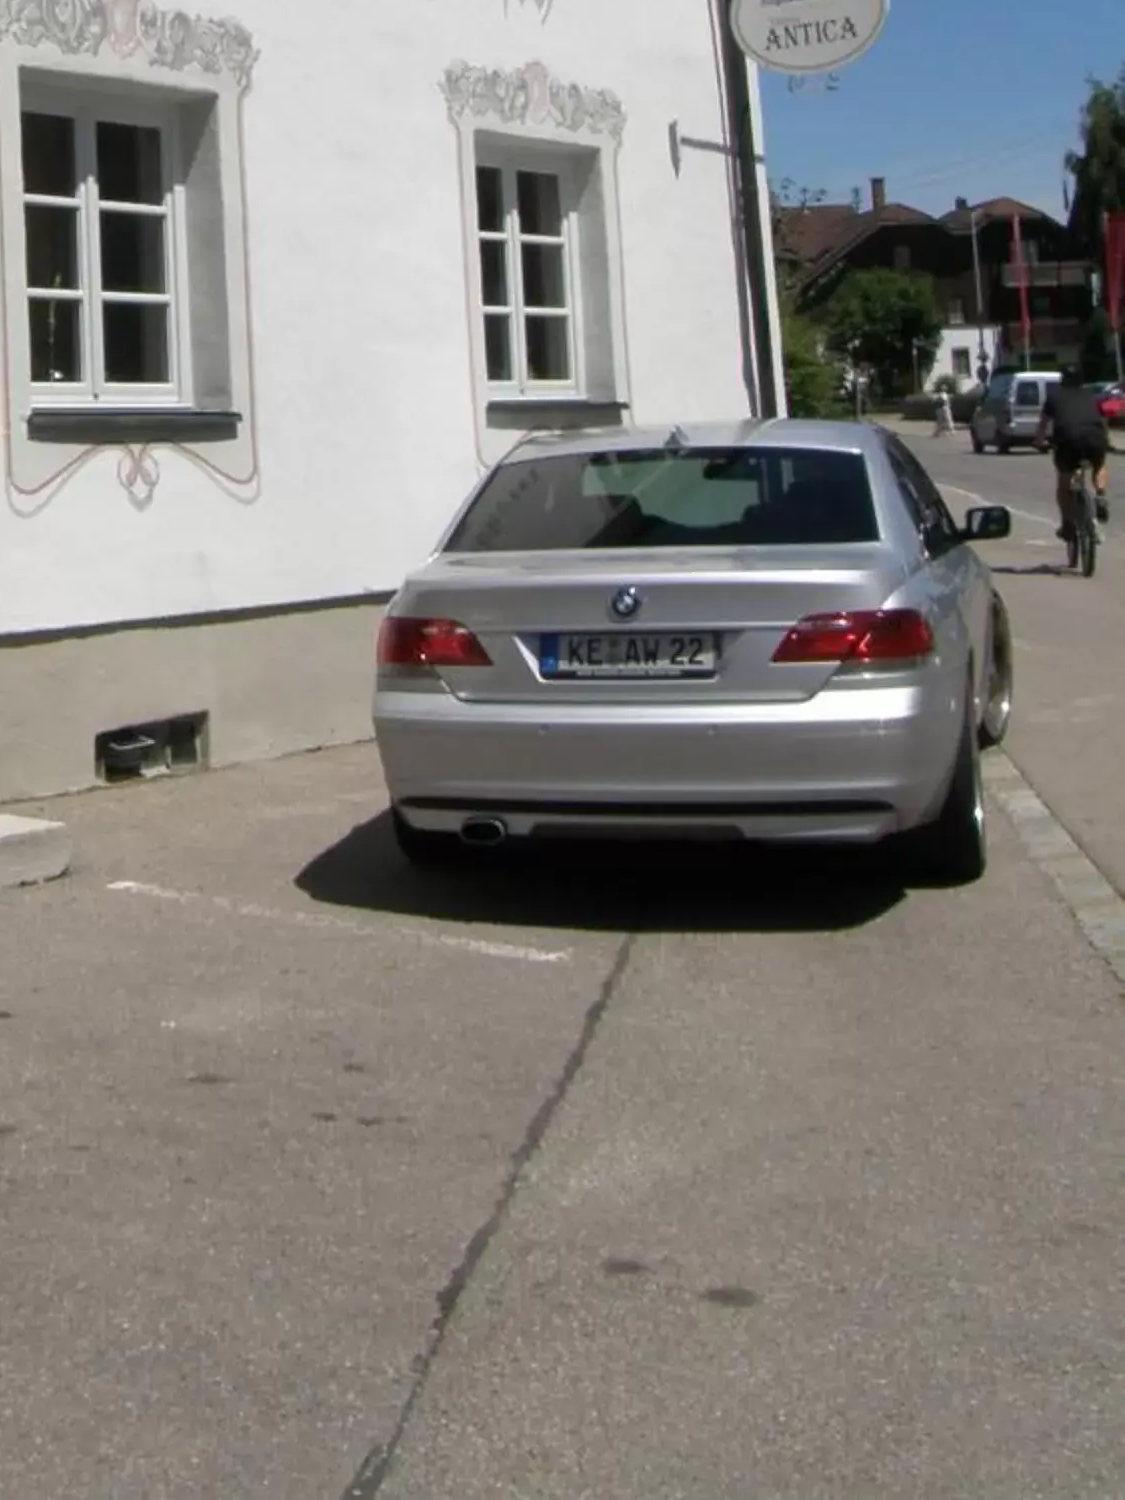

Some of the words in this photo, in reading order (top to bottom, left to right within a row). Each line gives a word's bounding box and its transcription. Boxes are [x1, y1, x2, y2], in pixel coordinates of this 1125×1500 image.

[764, 15, 858, 51] ANTICA
[567, 636, 604, 666] KE
[625, 636, 660, 666] AW
[669, 636, 704, 666] 22
